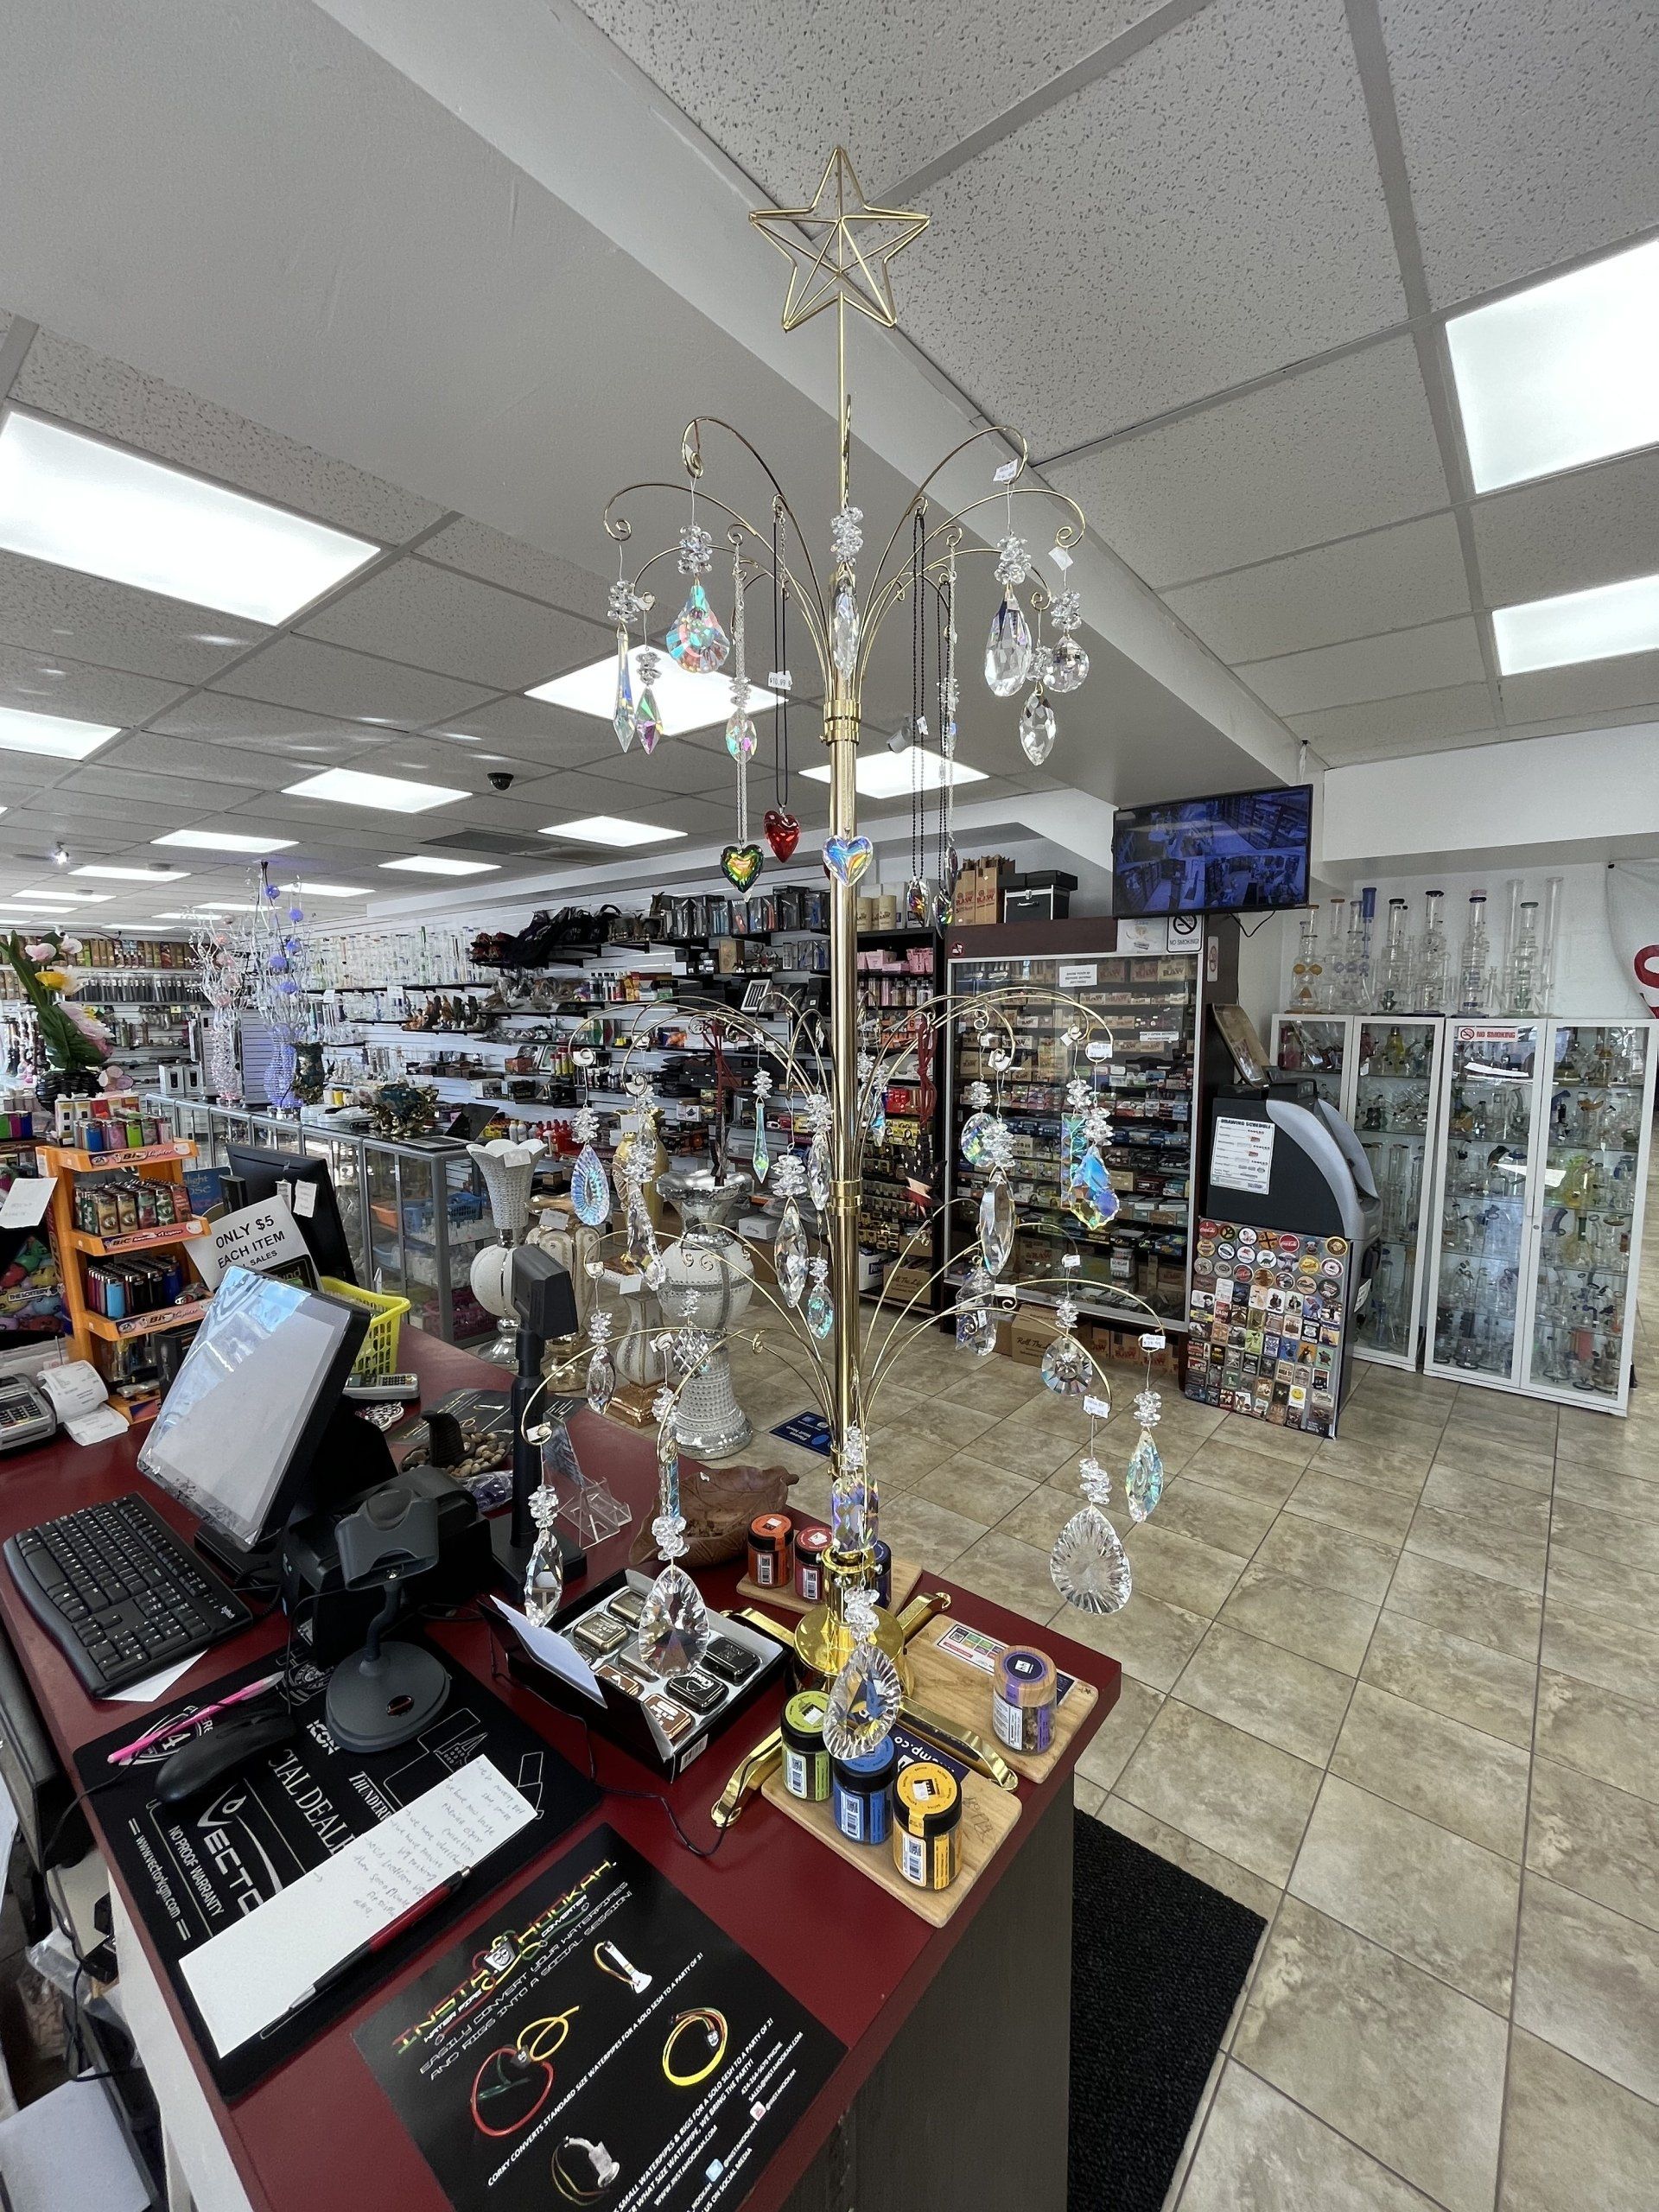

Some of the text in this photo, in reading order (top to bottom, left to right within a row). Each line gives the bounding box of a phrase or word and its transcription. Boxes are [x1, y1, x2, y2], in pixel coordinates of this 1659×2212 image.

[216, 1215, 275, 1249] ONLY $5
[218, 1230, 285, 1268] EACH ITEM
[250, 1249, 278, 1266] SALES
[168, 1825, 225, 1916] NO PROOF WARRANTY
[420, 1881, 628, 2074] EASILY CONVERT YOUR WATERPIPES
[424, 1894, 588, 2044] WATER PIPE CONVERTER
[430, 2051, 460, 2081] AND
[462, 2018, 496, 2050] RIGS
[497, 1987, 528, 2018] INTO
[531, 1978, 540, 1987] A
[541, 1938, 584, 1977] SOCIAL
[487, 2159, 511, 2186] CORKY
[511, 2125, 544, 2162] CONVERTS
[543, 2089, 576, 2126] STANDARD
[575, 2075, 588, 2091] SIZE
[588, 2039, 622, 2078] WATERPIPES
[621, 2027, 633, 2042] FOR
[637, 2007, 652, 2024] SOLO
[651, 1993, 664, 2011] SESH
[663, 1986, 671, 1997] TO
[675, 1965, 691, 1984] PARTY
[690, 1957, 697, 1967] OF
[767, 2041, 783, 2061] PHONE
[618, 2184, 639, 2212] SMALL
[639, 2139, 675, 2186] WATERPIPES
[674, 2133, 680, 2143] &
[679, 2117, 693, 2136] RIGS
[692, 2103, 704, 2120] FOR
[708, 2081, 722, 2101] SOLO
[721, 2065, 734, 2083] SESH
[734, 2057, 742, 2068] TO
[745, 2032, 761, 2053] PARTY
[760, 2024, 768, 2035] OF
[636, 2181, 656, 2207] WHAT
[655, 2165, 668, 2184] SIZE
[699, 2113, 710, 2127] WE
[709, 2093, 727, 2116] BRING
[725, 2080, 737, 2095] THE
[711, 2190, 721, 2203] ON
[719, 2168, 737, 2193] SOCIAL
[734, 2147, 753, 2171] MEDIA
